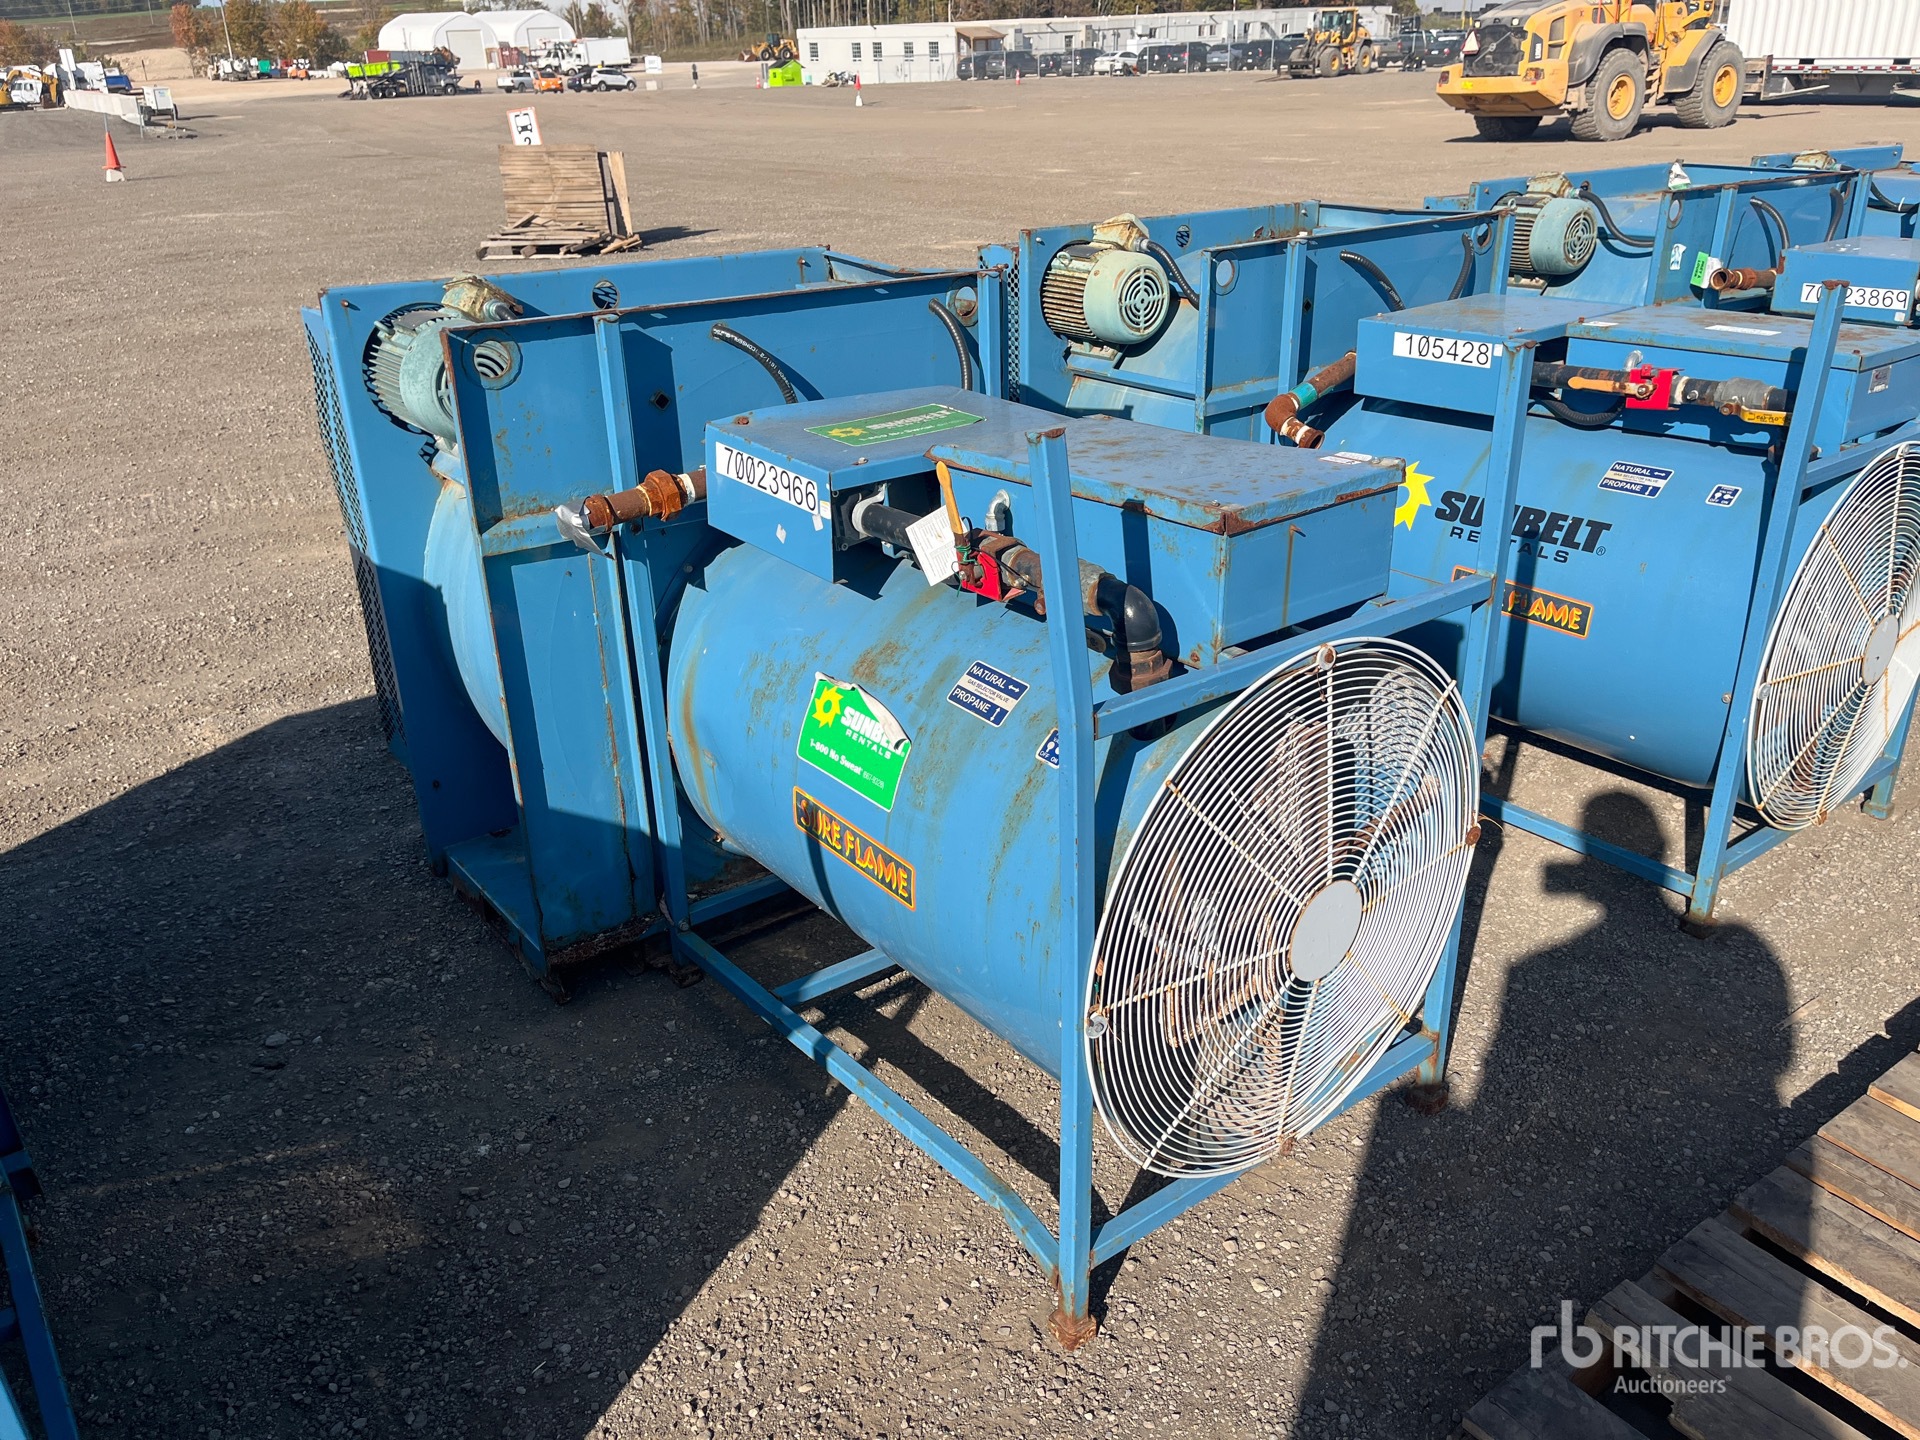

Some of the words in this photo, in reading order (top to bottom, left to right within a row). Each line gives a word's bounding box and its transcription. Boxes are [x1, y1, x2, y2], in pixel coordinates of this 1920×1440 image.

[1406, 334, 1489, 365] 105428
[725, 446, 817, 511] 70023966
[1602, 479, 1643, 492] PROPANE
[1613, 464, 1651, 476] NATURAL
[1435, 490, 1613, 554] SUBELT
[1508, 590, 1583, 630] FLAME
[970, 665, 1008, 689] NATURAL
[975, 682, 997, 698] SELECTOR
[996, 693, 1010, 703] VALVE
[952, 688, 992, 713] PROPANE
[810, 738, 829, 756] 1-800
[829, 748, 839, 762] No
[840, 755, 862, 775] Sweat
[845, 728, 892, 760] RENTALS
[1040, 750, 1050, 758] OFF
[800, 799, 842, 850] SURE
[843, 829, 909, 898] FLAME
